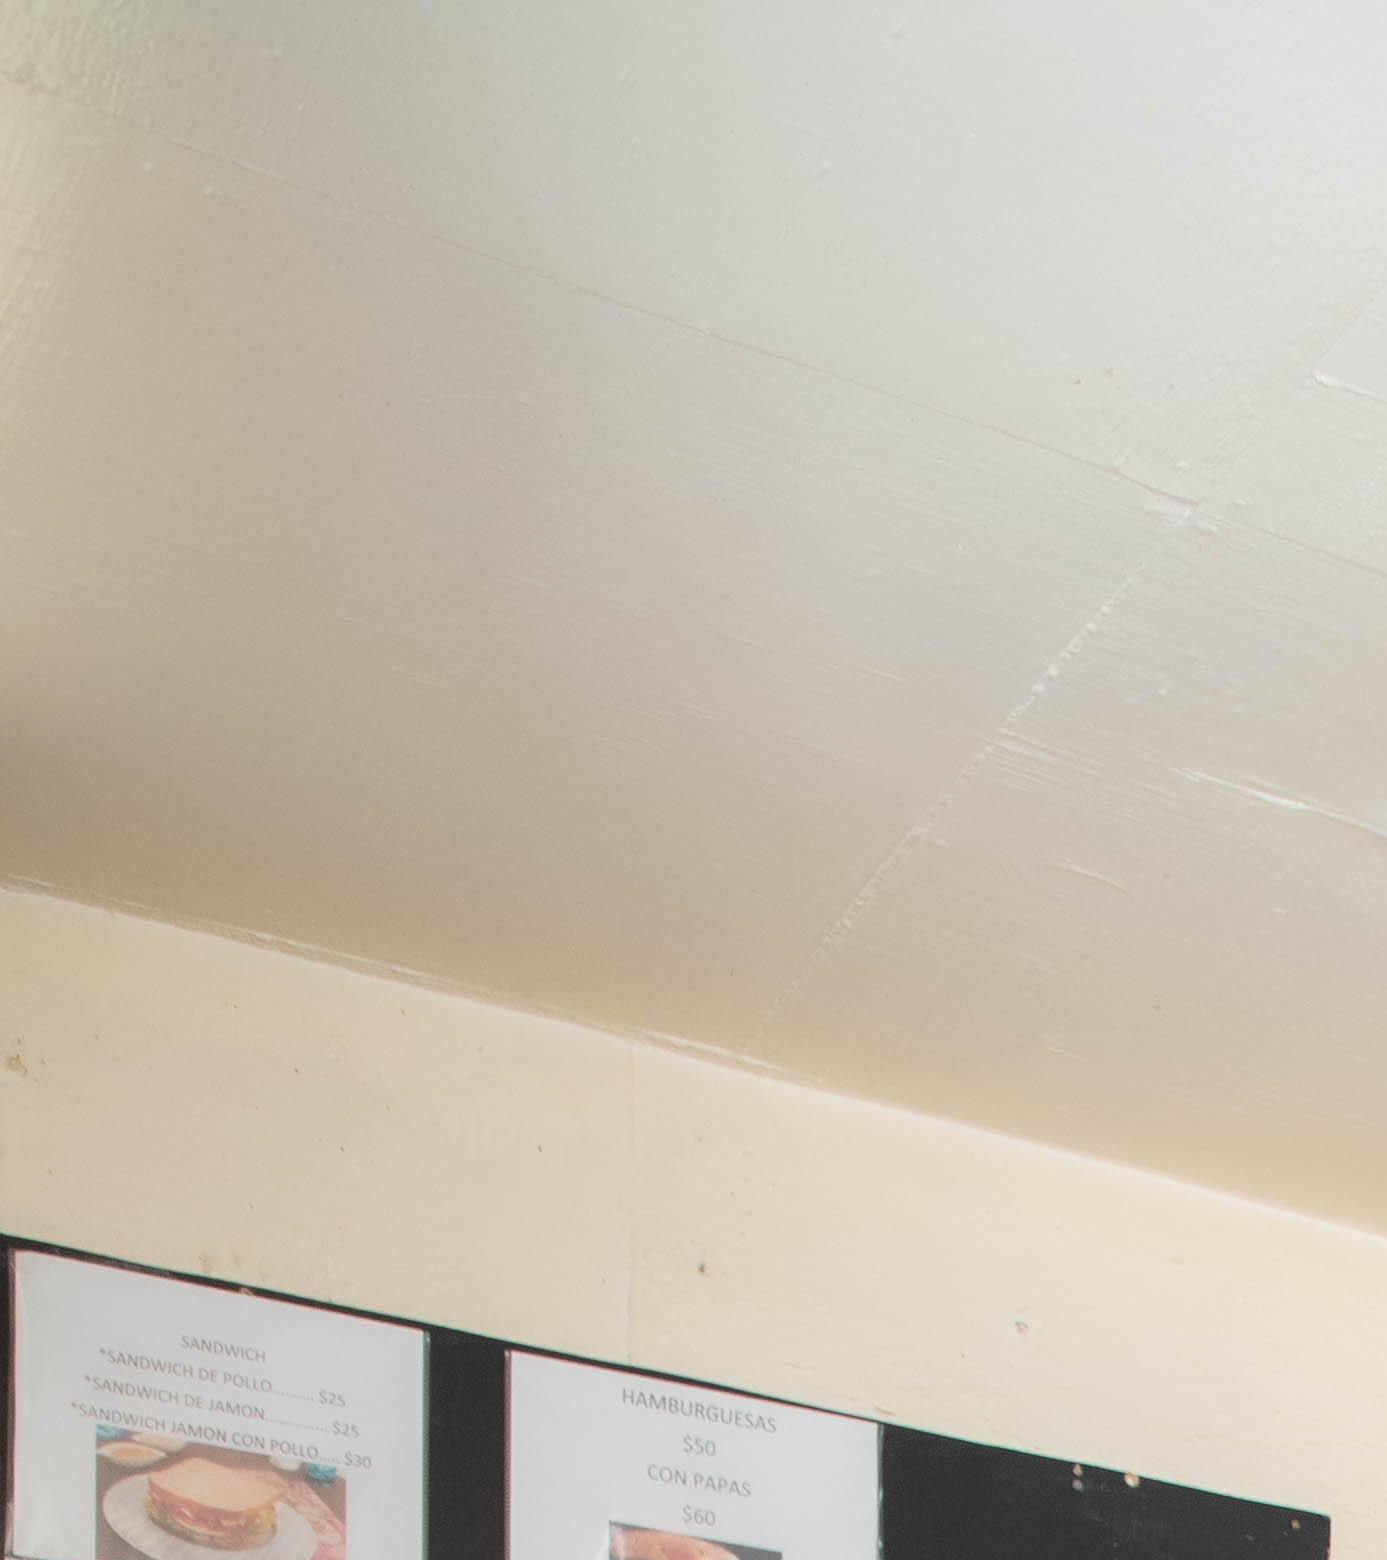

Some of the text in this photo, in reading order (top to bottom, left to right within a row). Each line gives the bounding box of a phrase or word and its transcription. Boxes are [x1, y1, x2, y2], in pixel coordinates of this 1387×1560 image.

[180, 1335, 266, 1363] SANDWICH
[198, 1366, 219, 1382] DE
[223, 1370, 272, 1393] POLLO
[318, 1389, 346, 1407] $25
[184, 1393, 205, 1409] DE
[208, 1397, 265, 1421] JAMON
[332, 1419, 360, 1438] $25
[621, 1388, 777, 1434] HAMBURGUESAS
[171, 1420, 227, 1444] JAMON
[231, 1430, 265, 1449] CON
[269, 1439, 319, 1459] POLLO
[344, 1450, 372, 1469] $30
[682, 1435, 717, 1457] $50
[647, 1463, 752, 1498] CON PAPAS
[681, 1505, 716, 1526] $60
